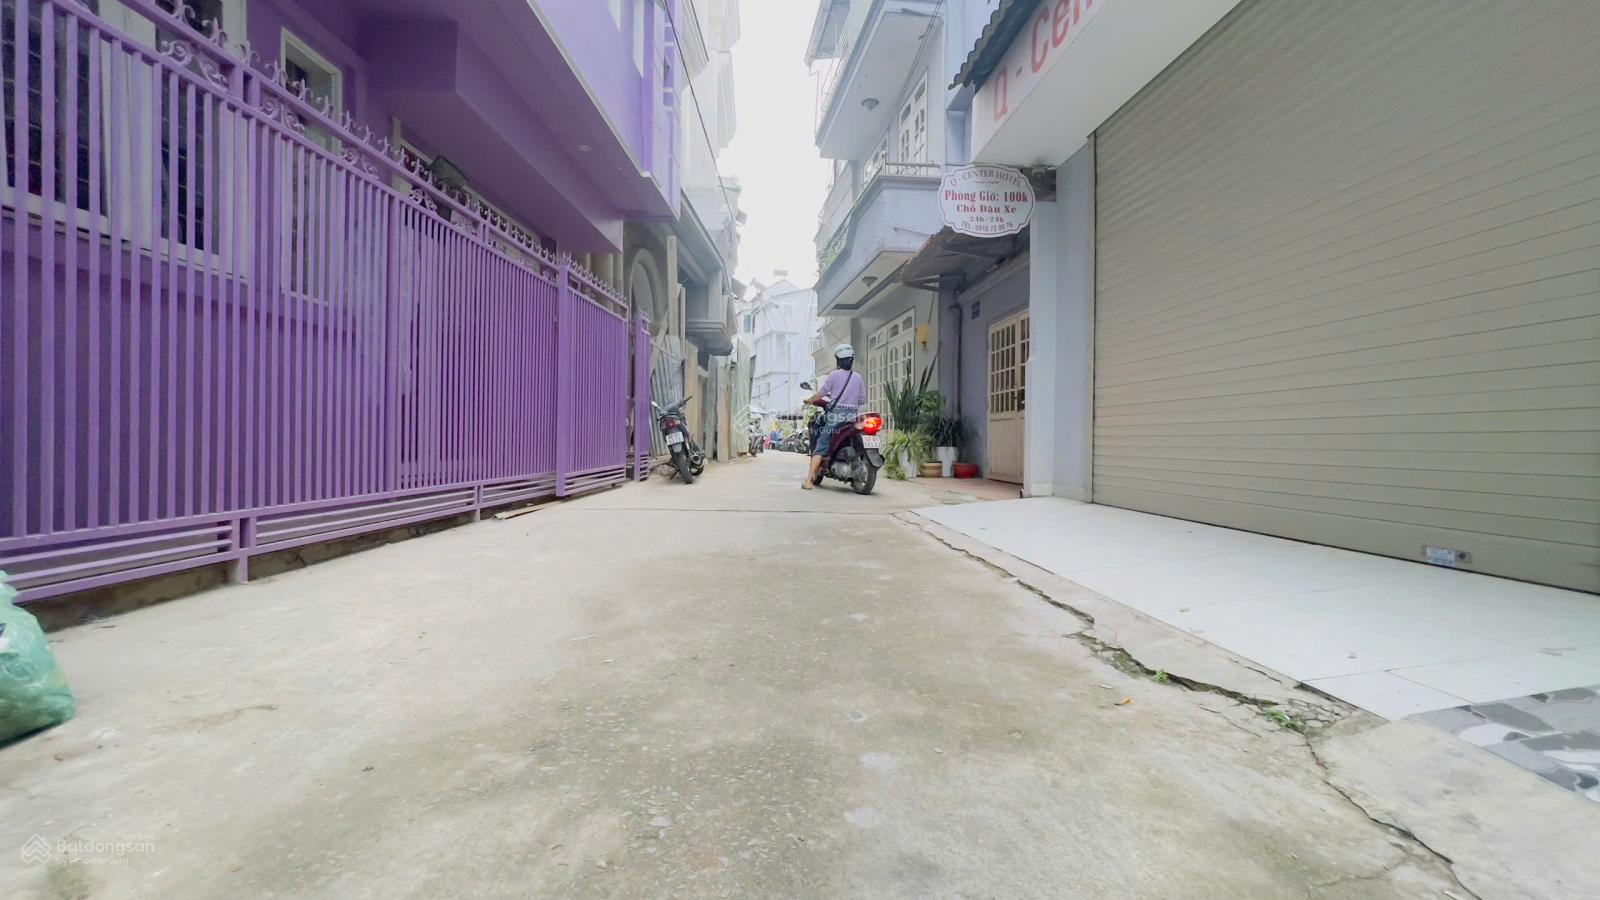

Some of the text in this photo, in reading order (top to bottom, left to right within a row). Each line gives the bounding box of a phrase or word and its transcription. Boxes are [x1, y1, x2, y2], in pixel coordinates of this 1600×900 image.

[992, 66, 1008, 122] Q
[962, 168, 994, 181] CENTER
[995, 170, 1022, 187] HOTEL
[1003, 191, 1029, 203] 100k
[1004, 204, 1017, 214] Xe
